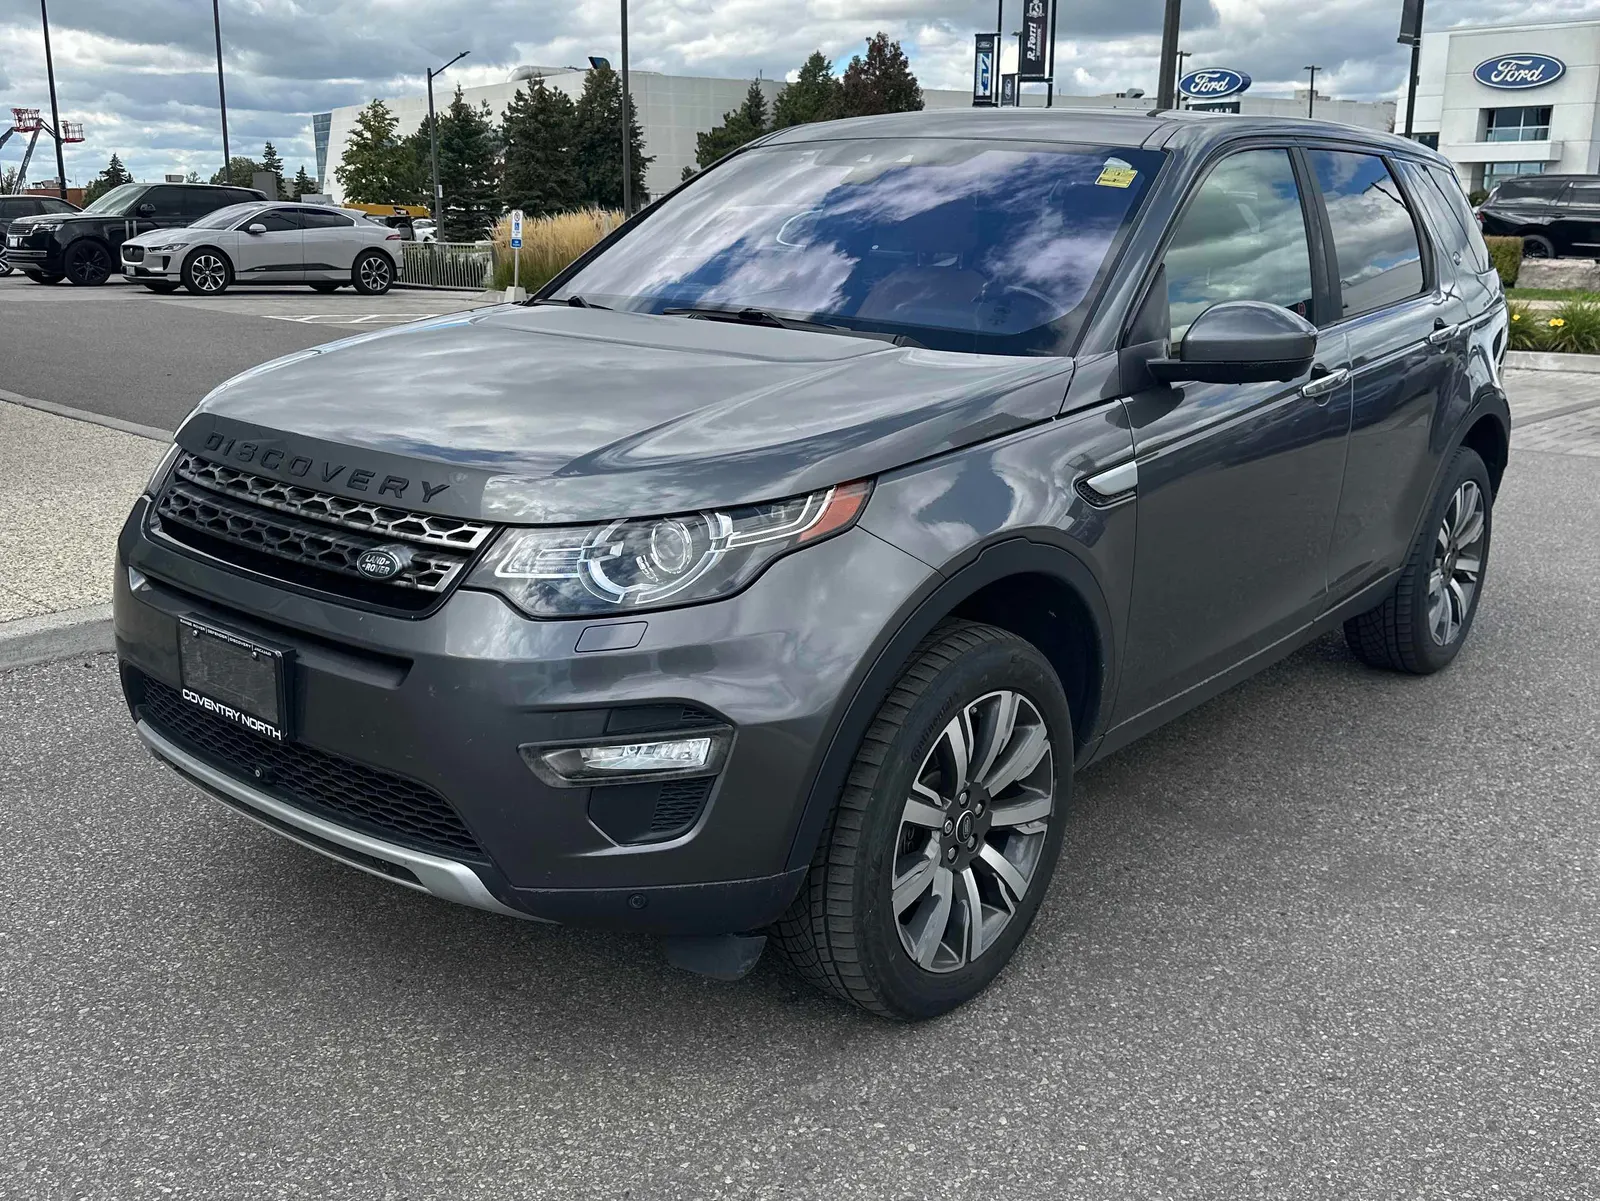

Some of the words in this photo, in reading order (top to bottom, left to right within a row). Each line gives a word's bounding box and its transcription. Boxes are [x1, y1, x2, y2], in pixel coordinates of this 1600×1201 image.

[1491, 59, 1546, 82] Ford
[1190, 73, 1230, 93] Ford
[203, 431, 451, 503] DISCOVERY
[364, 563, 391, 575] ROVER
[365, 554, 386, 565] LAND
[182, 688, 241, 722] COVENTRY
[241, 713, 282, 741] NORTH
